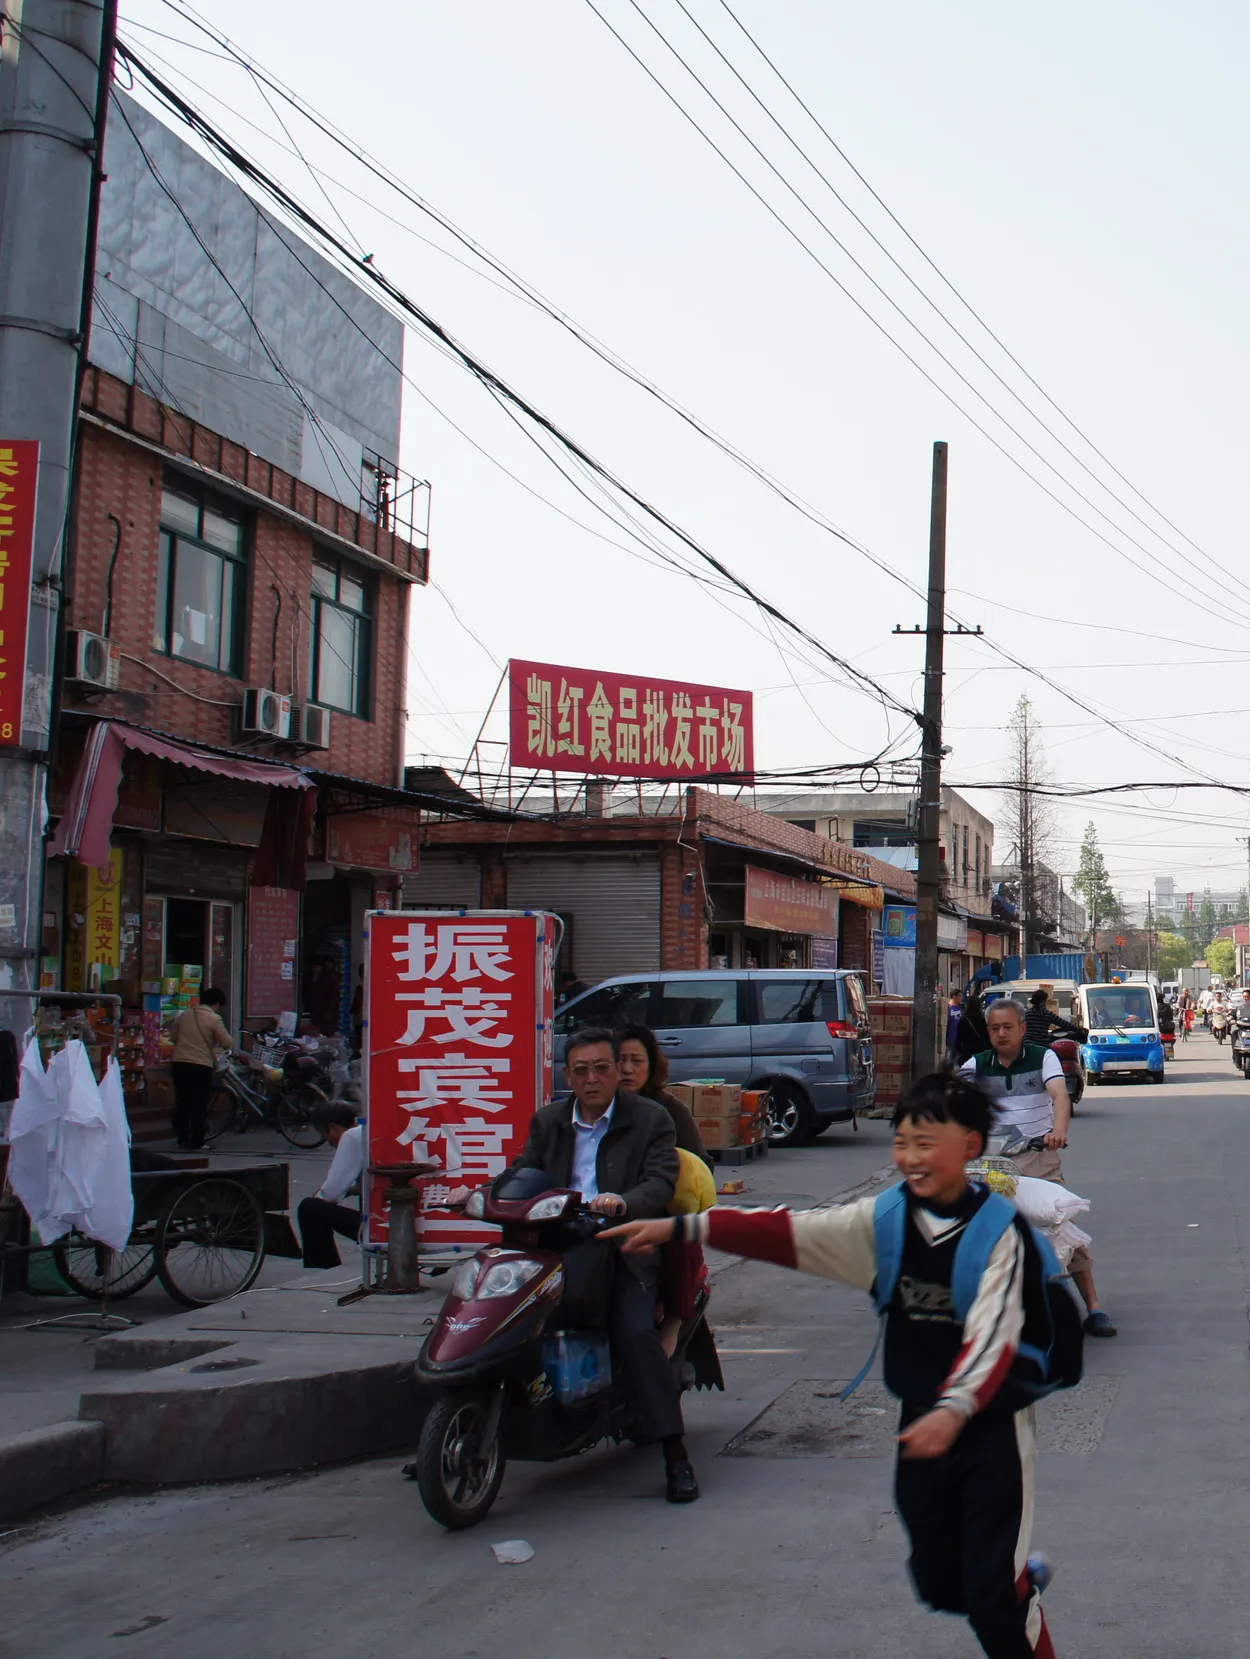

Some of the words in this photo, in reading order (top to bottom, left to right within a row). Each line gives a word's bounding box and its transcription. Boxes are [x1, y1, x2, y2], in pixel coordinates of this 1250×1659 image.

[526, 673, 745, 772] 凯红食品批发市场
[391, 923, 516, 1179] 振茂宾馆
